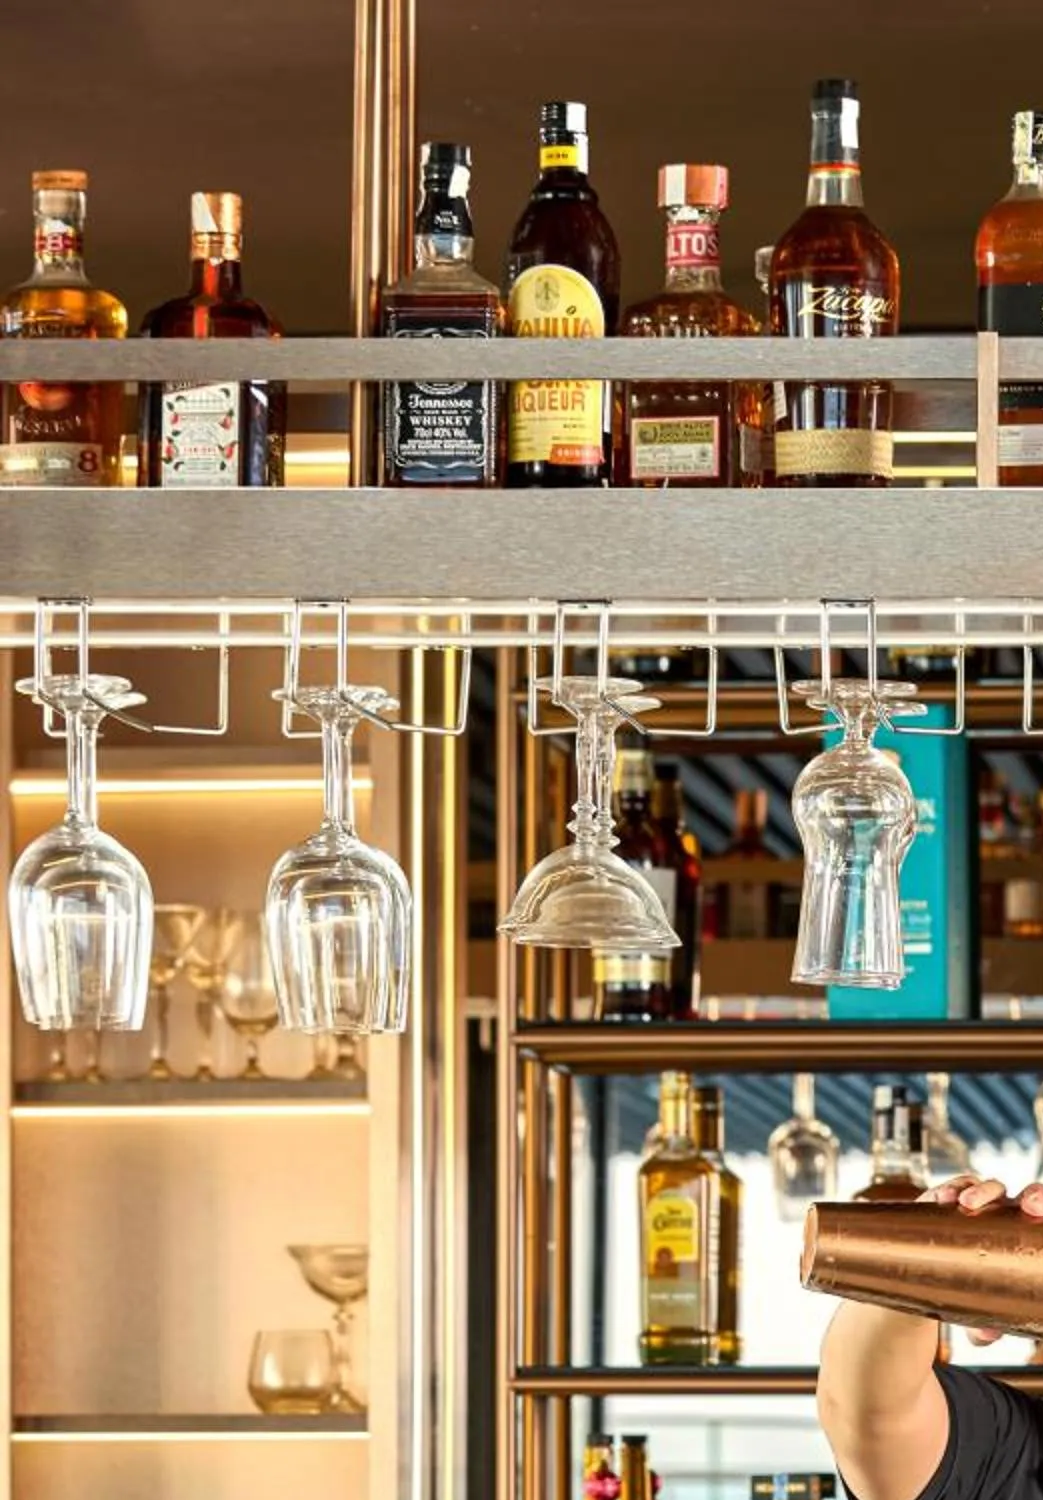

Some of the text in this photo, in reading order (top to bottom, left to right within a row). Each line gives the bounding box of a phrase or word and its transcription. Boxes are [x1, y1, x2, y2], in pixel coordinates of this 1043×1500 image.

[667, 233, 720, 257] LTOS
[408, 394, 474, 409] Tennessee
[409, 415, 473, 427] WHISKEY
[78, 451, 99, 473] 8
